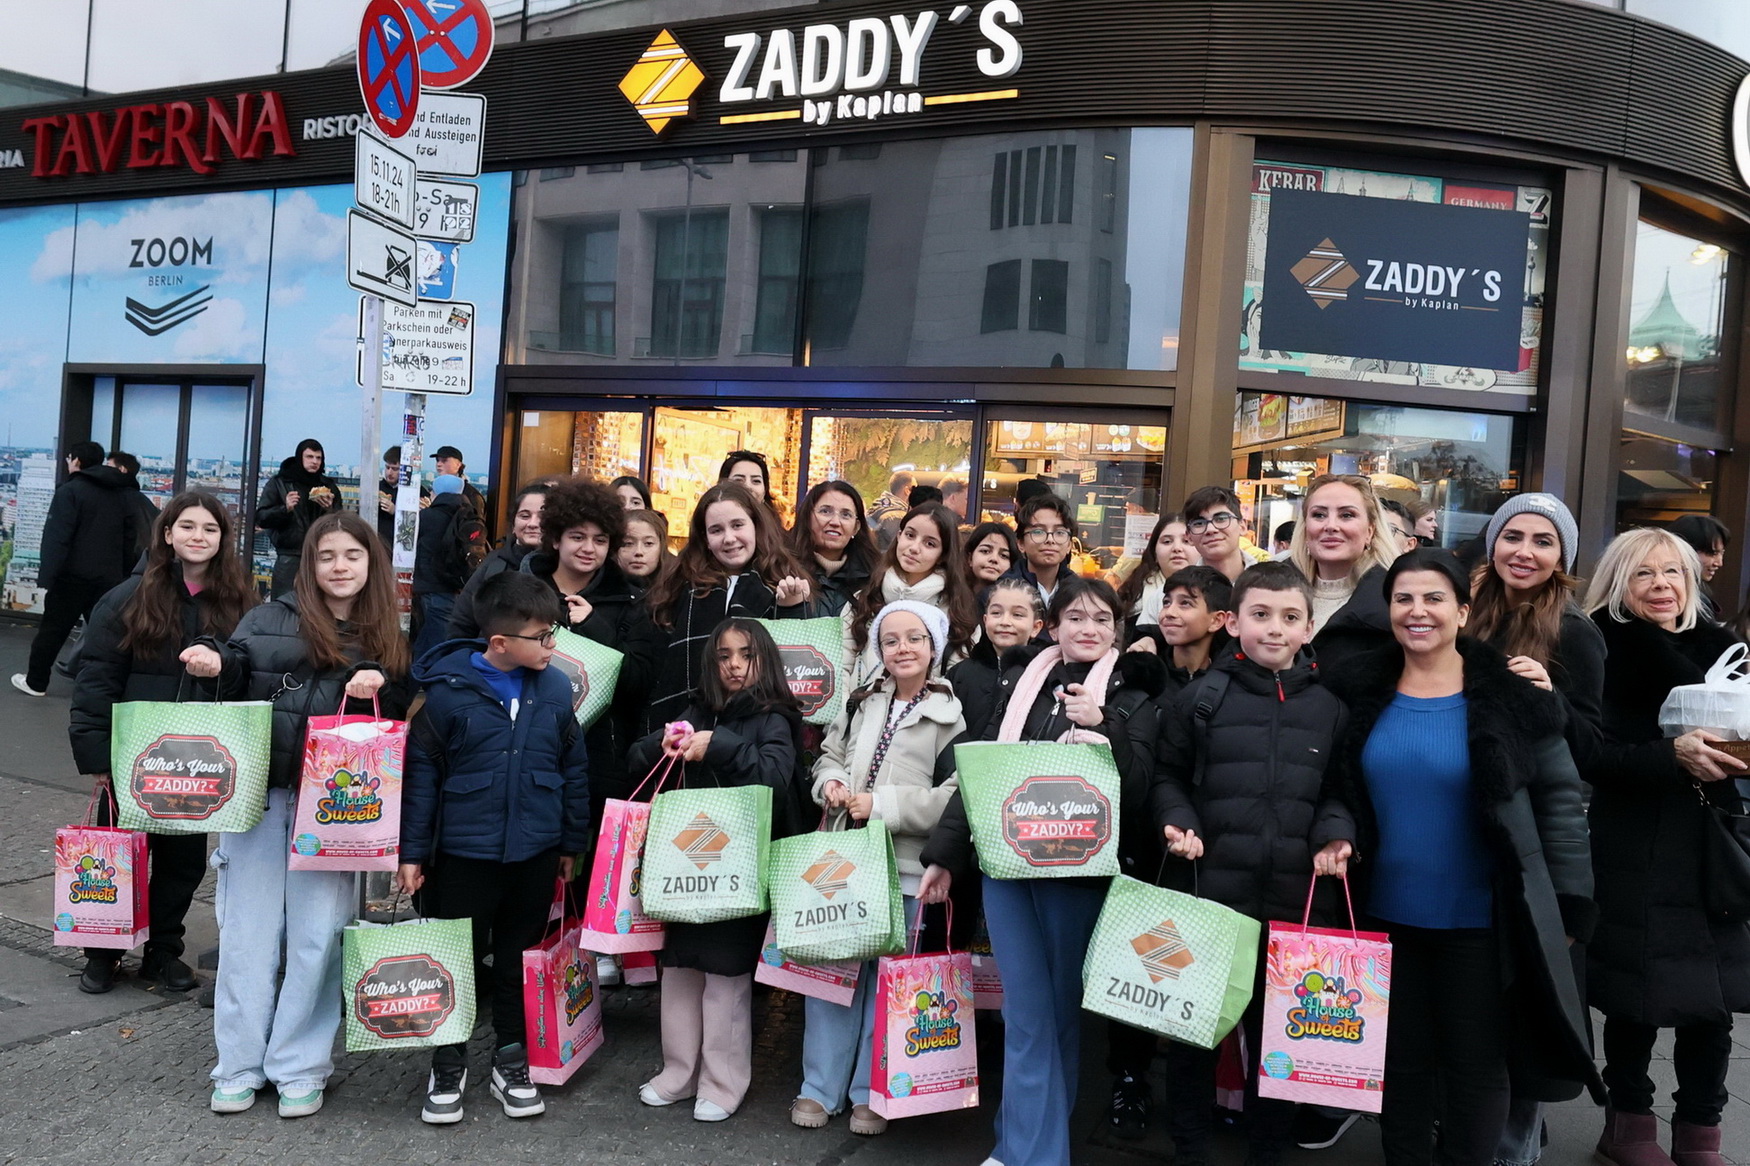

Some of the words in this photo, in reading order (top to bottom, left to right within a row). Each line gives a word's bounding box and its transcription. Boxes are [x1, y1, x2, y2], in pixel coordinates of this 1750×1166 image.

[803, 99, 831, 126] by
[837, 90, 924, 120] Kaplan
[429, 112, 471, 126] Entladen
[22, 91, 298, 178] TAVERNA
[425, 127, 477, 144] Aussteigen
[416, 143, 438, 157] frei
[370, 153, 403, 189] 15.11.24
[371, 181, 400, 215] 18-21h
[1450, 197, 1508, 211] GERMANY
[128, 235, 214, 269] ZOOM
[148, 275, 183, 287] BERLIN
[393, 306, 425, 319] Parken
[428, 307, 443, 319] mit
[1404, 296, 1418, 309] by
[1421, 297, 1459, 310] Kaplan
[433, 323, 454, 335] oder
[395, 337, 467, 351] nerparkausweis
[383, 370, 395, 381] Sa
[427, 374, 458, 387] 19-22
[460, 376, 467, 387] h
[793, 664, 826, 681] Your
[142, 756, 185, 772] Who's
[186, 758, 226, 777] Your
[154, 778, 208, 793] ZADDY?
[331, 788, 376, 808] House
[316, 798, 383, 823] Sweets
[1011, 800, 1059, 817] Who's
[1059, 800, 1100, 821] Your
[1029, 823, 1084, 837] ZADDY?
[79, 870, 112, 888] House
[69, 881, 118, 903] Sweets
[363, 979, 407, 998] Who's
[407, 977, 444, 997] Your
[380, 997, 430, 1014] ZADDY?
[1302, 995, 1354, 1019] House
[915, 1013, 954, 1033] House
[1287, 1008, 1362, 1041] Sweets
[906, 1025, 961, 1056] Sweets
